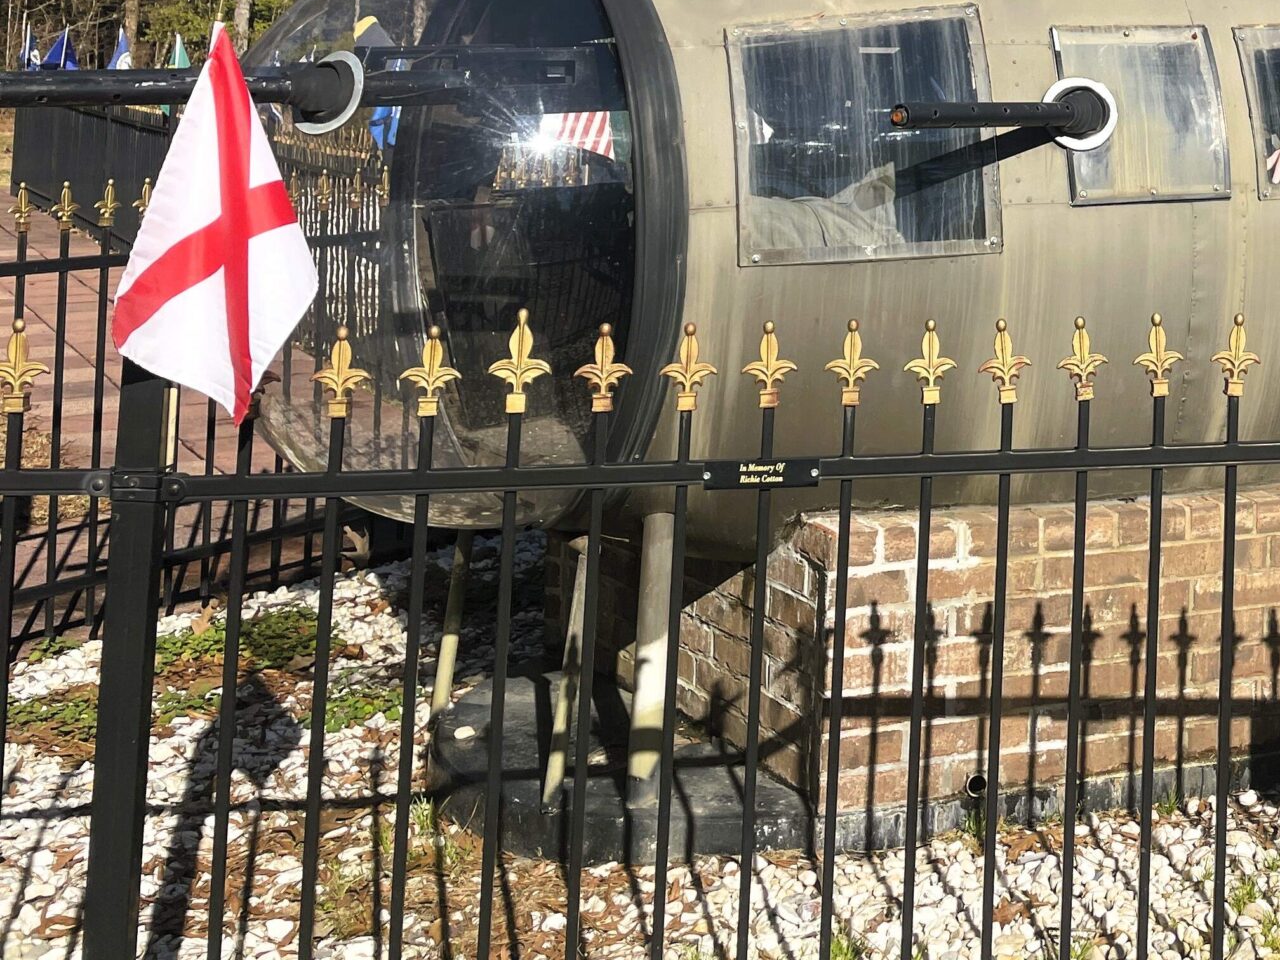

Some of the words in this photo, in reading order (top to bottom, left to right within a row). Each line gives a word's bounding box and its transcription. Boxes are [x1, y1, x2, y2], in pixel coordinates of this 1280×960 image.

[739, 463, 747, 472] In
[748, 463, 775, 473] Memory
[776, 462, 786, 473] Of
[739, 474, 760, 483] Richie
[761, 474, 783, 483] Cotton
